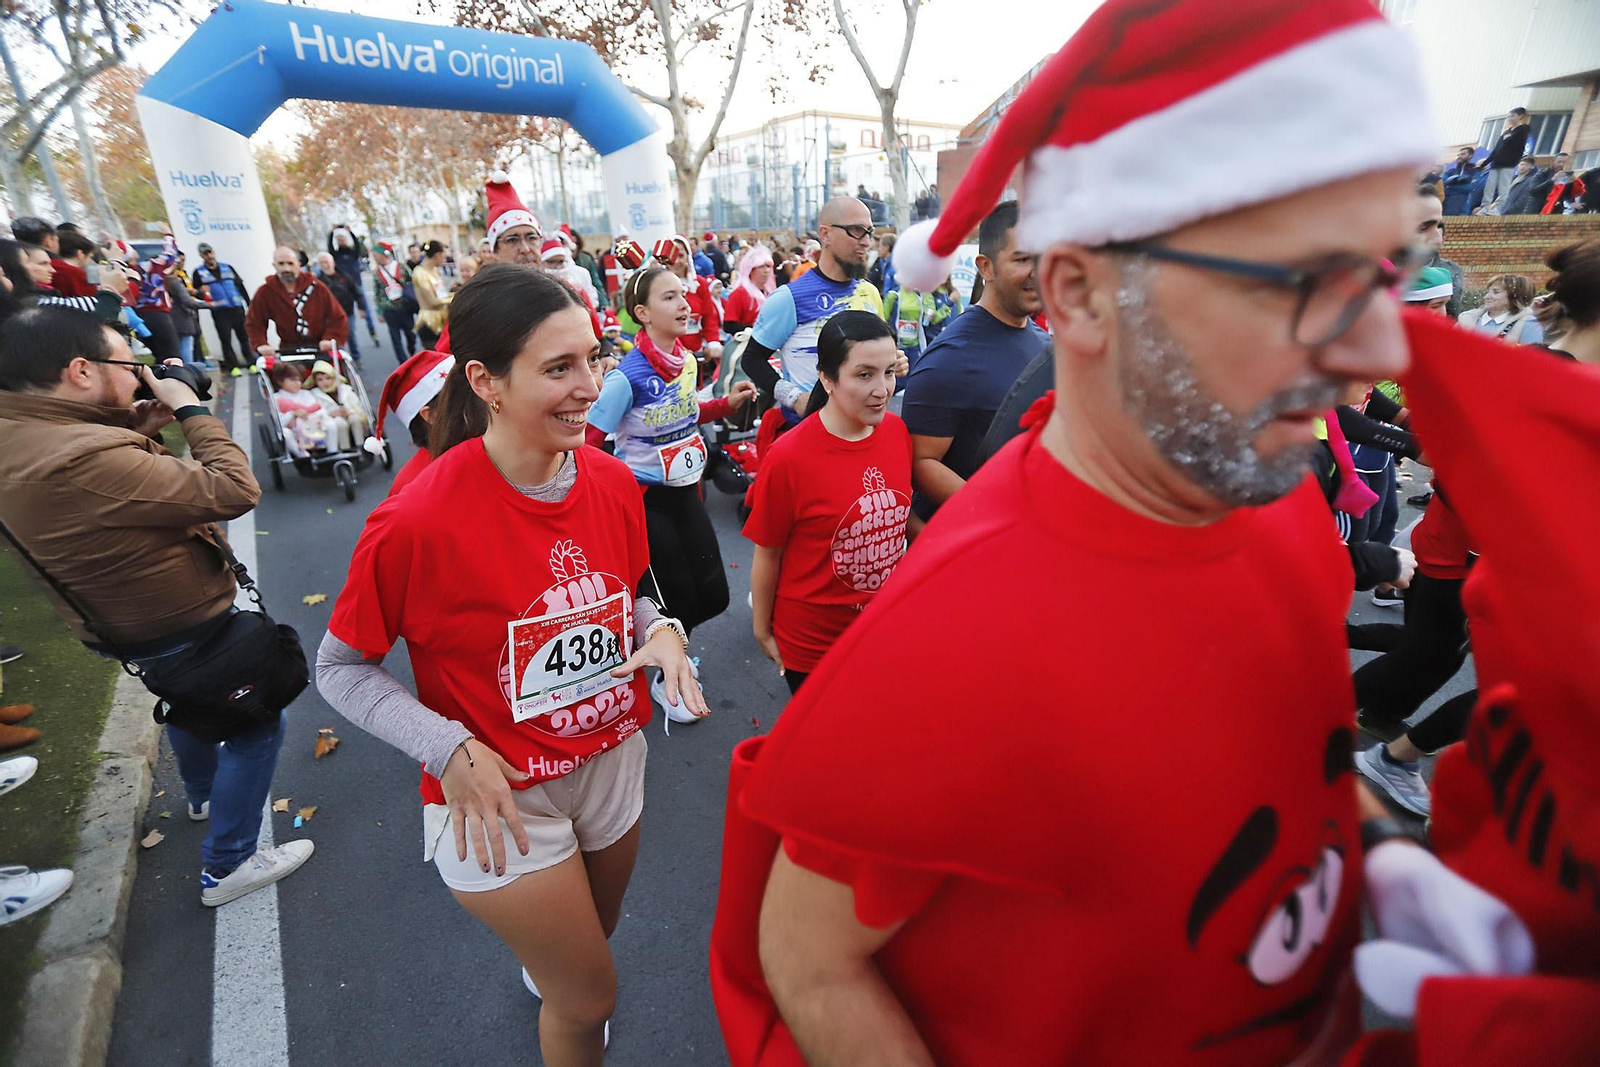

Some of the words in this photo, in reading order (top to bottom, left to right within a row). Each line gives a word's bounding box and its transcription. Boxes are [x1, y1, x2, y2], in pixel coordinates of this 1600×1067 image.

[288, 21, 438, 74] Huelva
[448, 44, 564, 89] original
[169, 170, 242, 188] Huelva
[208, 222, 252, 231] HUELVA
[1373, 434, 1406, 449] KIPSTA
[684, 452, 693, 469] 8
[859, 490, 897, 515] XIII
[864, 522, 906, 546] SILVEST
[853, 534, 906, 564] HUELV
[837, 564, 859, 575] 30
[859, 564, 873, 573] DE
[544, 628, 604, 677] 438
[550, 683, 635, 737] 2023
